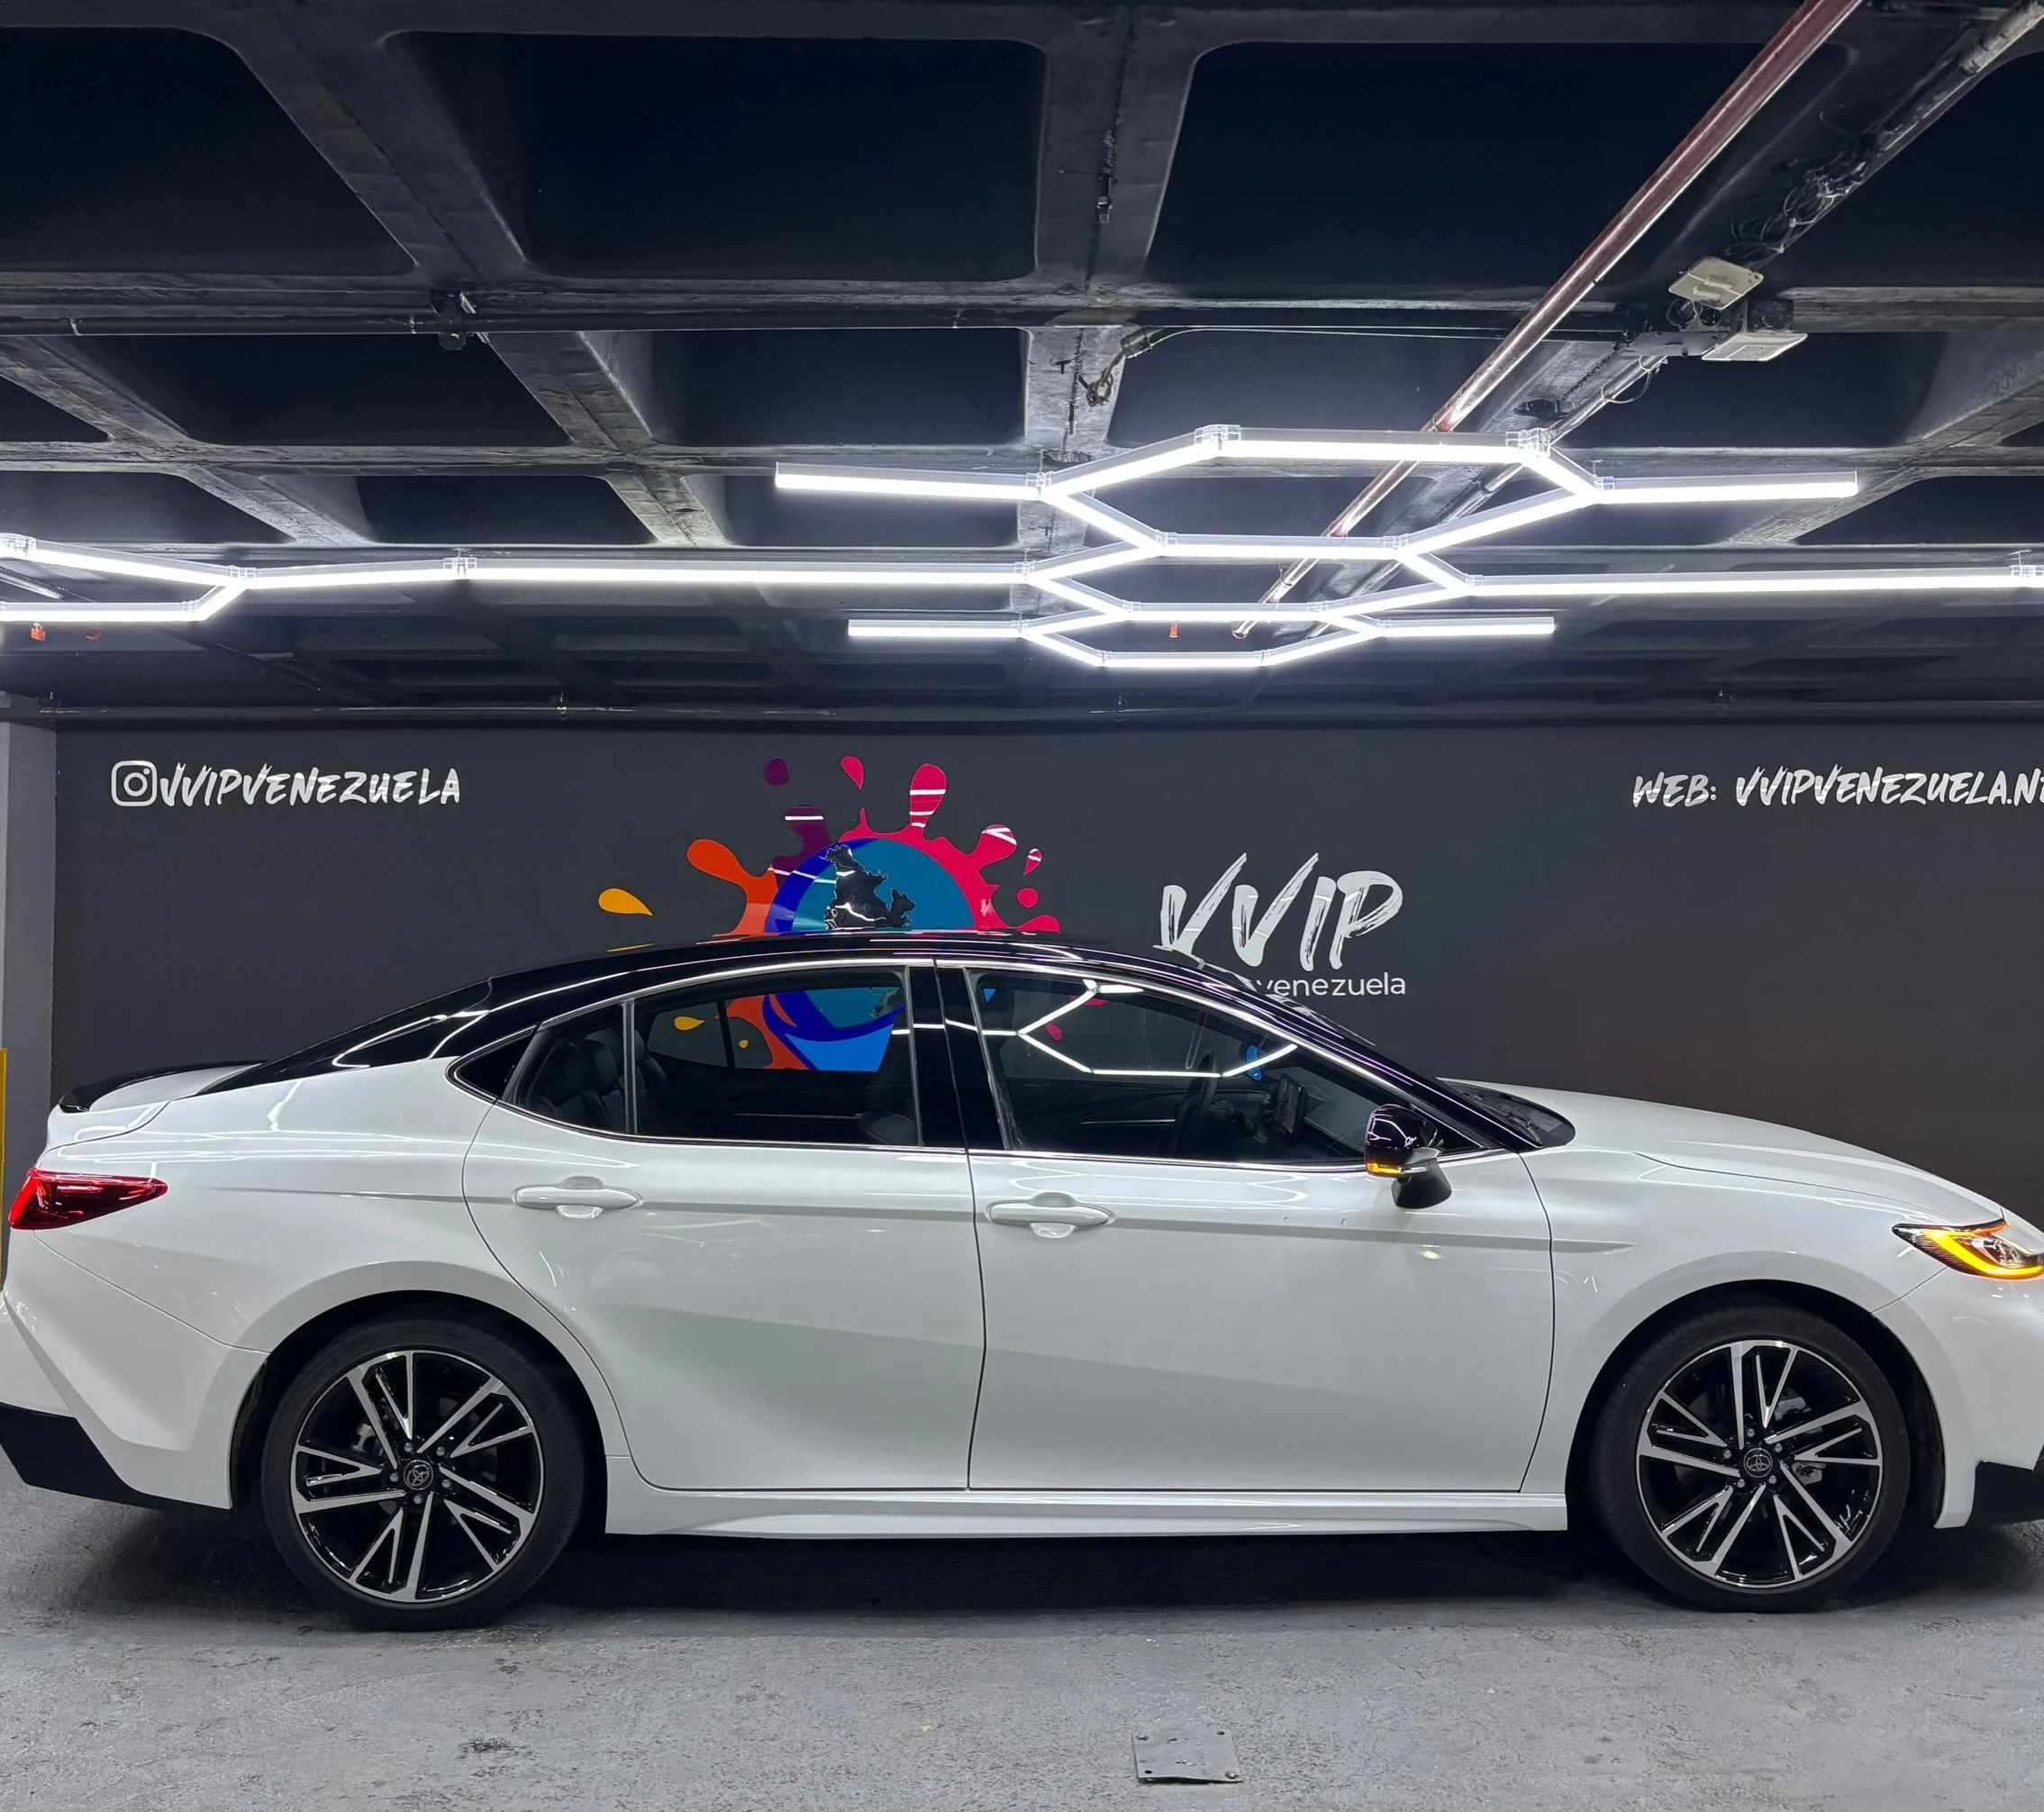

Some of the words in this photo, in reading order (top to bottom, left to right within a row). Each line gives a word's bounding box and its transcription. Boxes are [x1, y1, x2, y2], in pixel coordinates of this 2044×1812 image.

[159, 762, 460, 806] VVIPVENEZUELA
[1632, 771, 1717, 808] WEB:
[1735, 763, 2044, 806] VVIPVENEZUELA.N
[1159, 851, 1404, 972] VVIP
